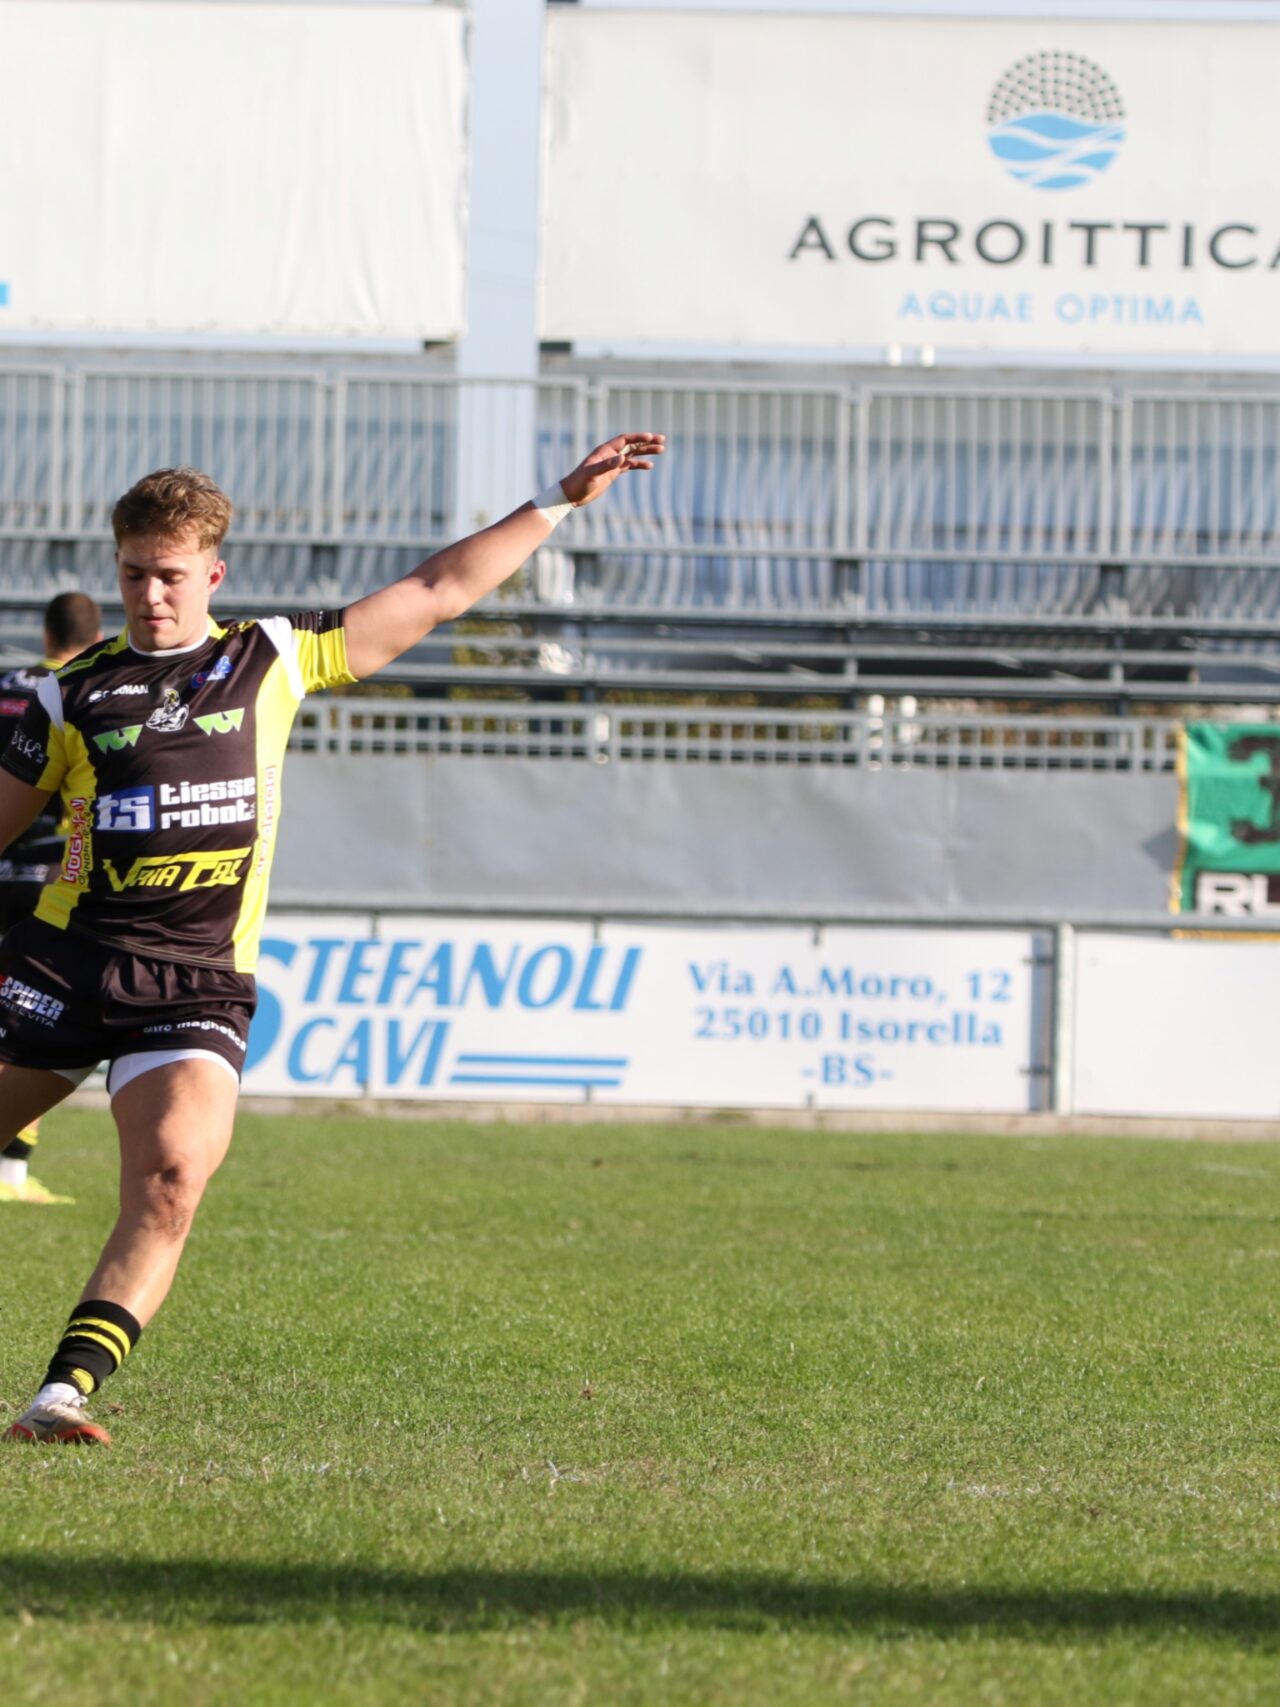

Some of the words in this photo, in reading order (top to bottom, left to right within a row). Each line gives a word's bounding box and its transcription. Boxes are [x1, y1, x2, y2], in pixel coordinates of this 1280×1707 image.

[898, 290, 1033, 323] AQUAE
[1055, 293, 1205, 326] OPTIMA
[160, 777, 255, 806] tiesse
[161, 799, 251, 829] robot
[0, 976, 65, 1021] SPIDER
[688, 961, 754, 994] Via
[773, 965, 947, 1005] A.Moro,
[967, 970, 1013, 1002] 12
[694, 1008, 822, 1040] 25010
[838, 1010, 1004, 1044] Isorella
